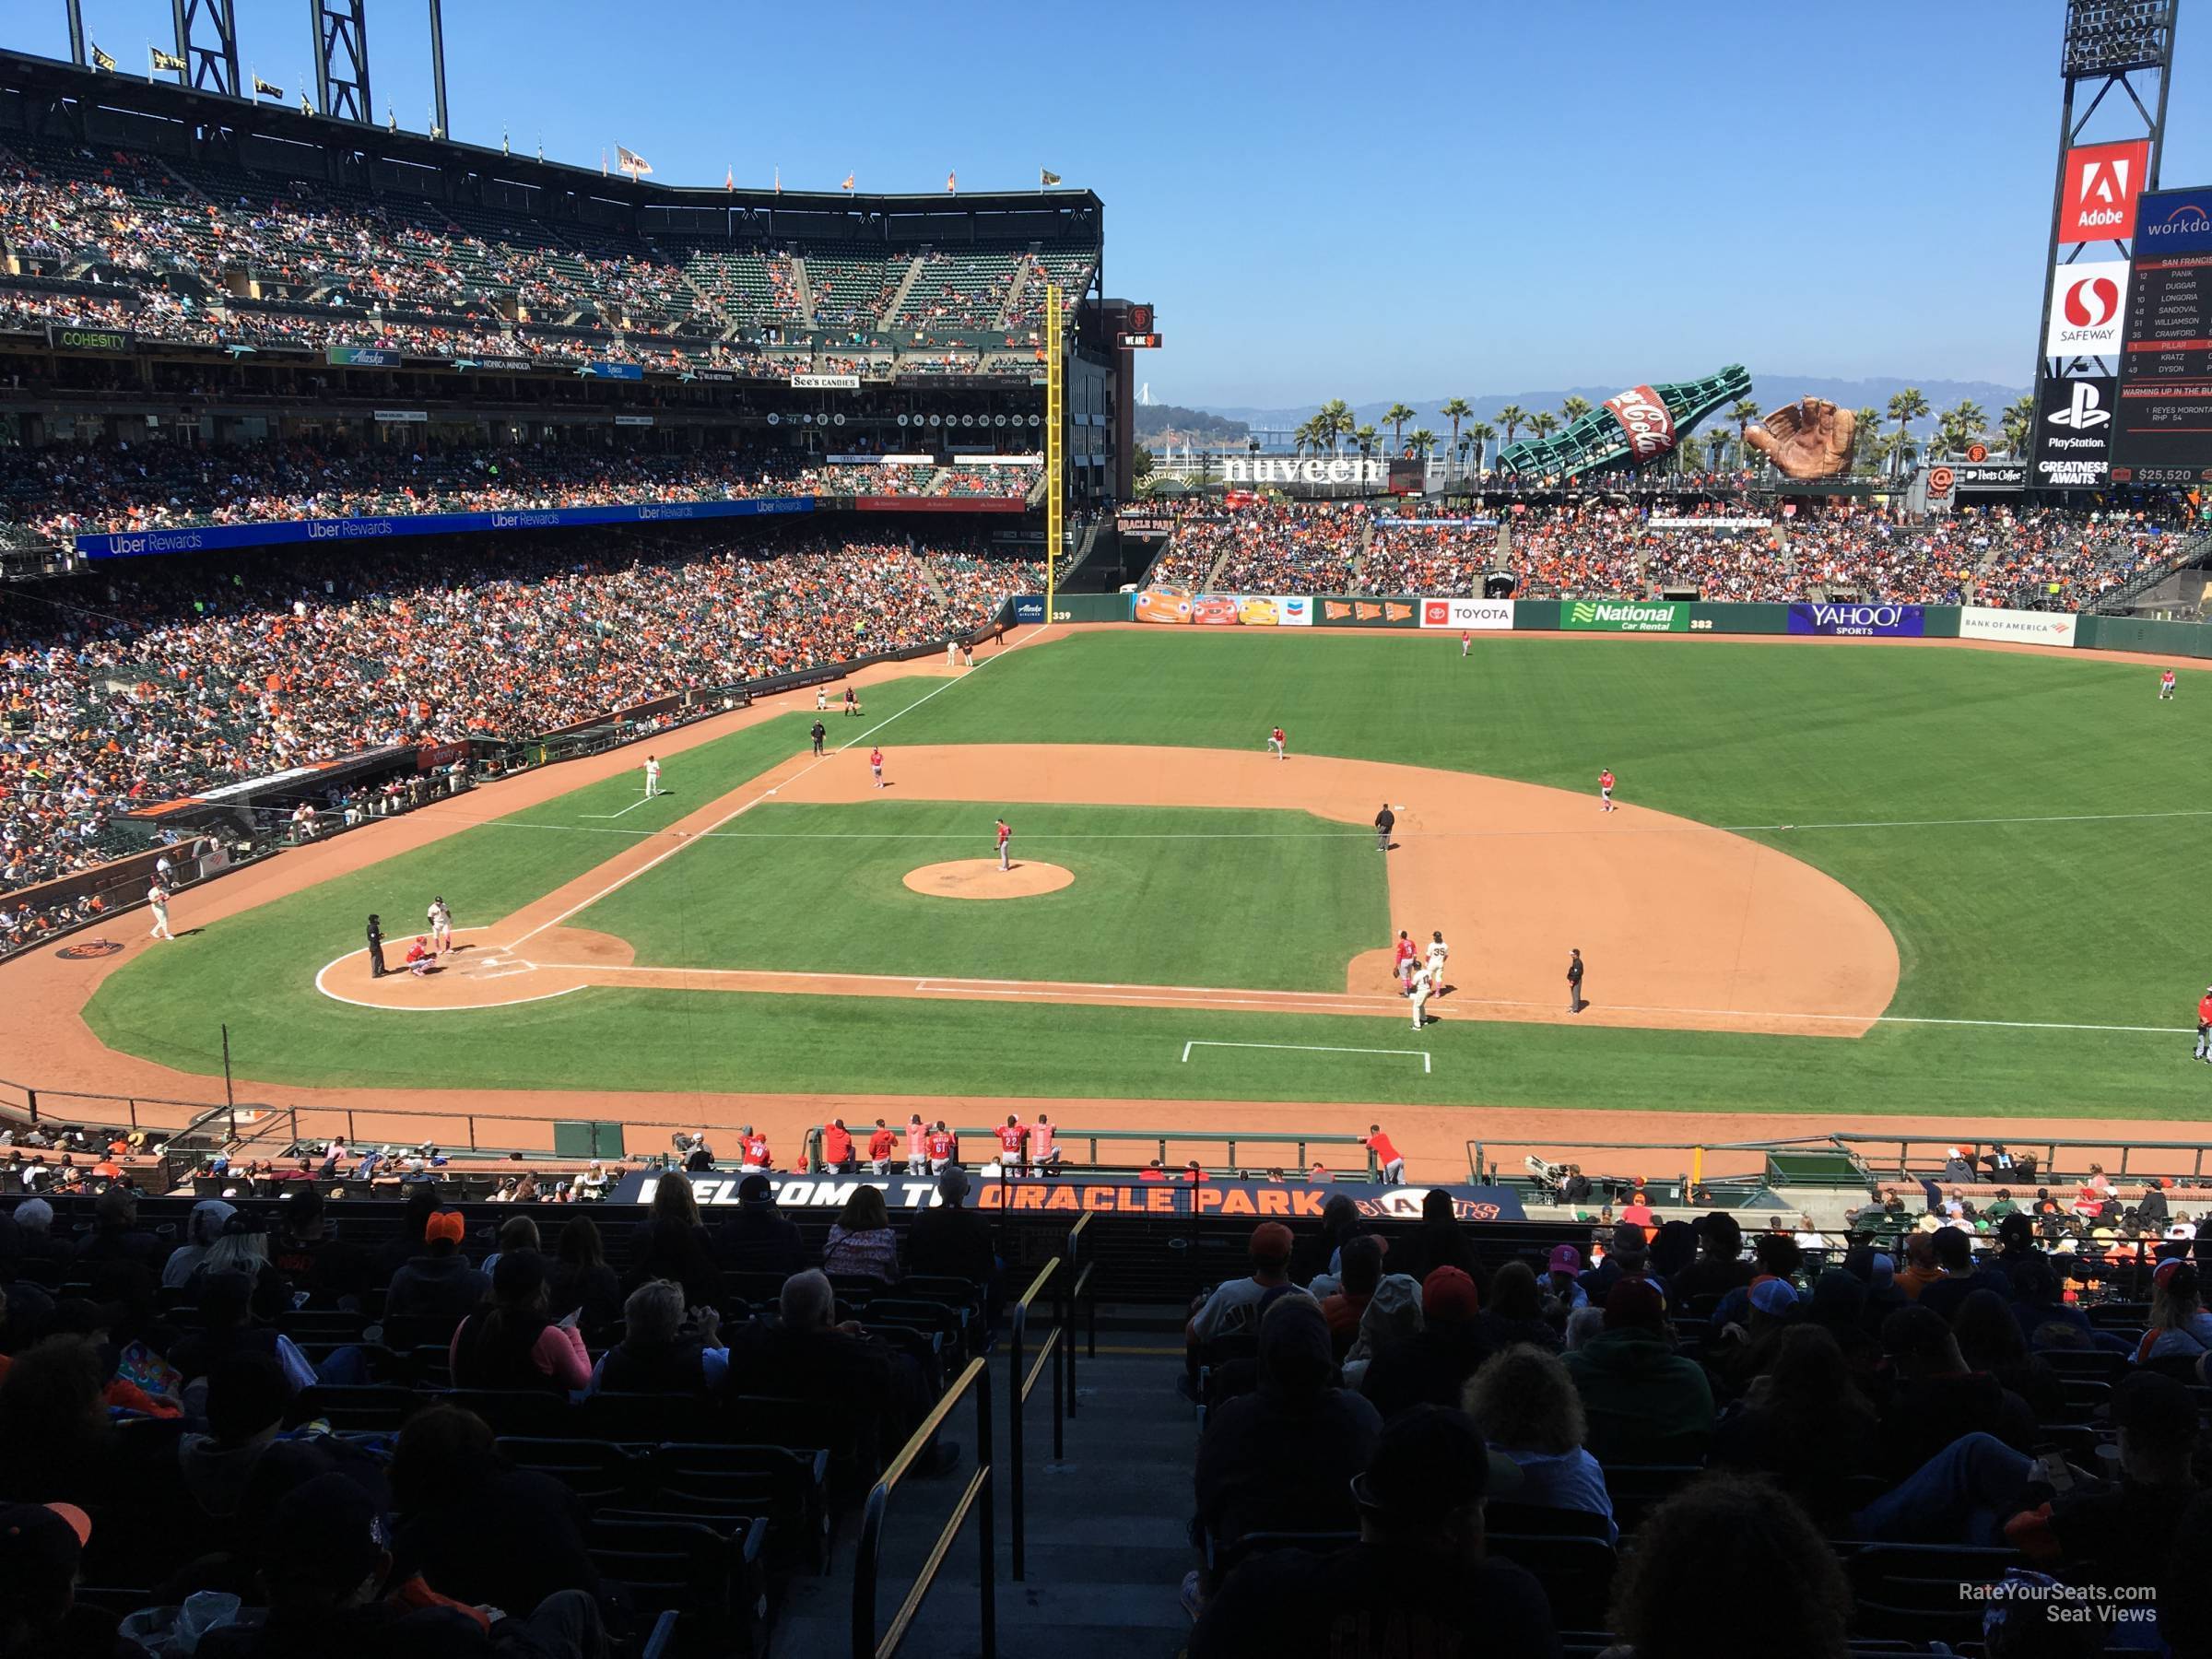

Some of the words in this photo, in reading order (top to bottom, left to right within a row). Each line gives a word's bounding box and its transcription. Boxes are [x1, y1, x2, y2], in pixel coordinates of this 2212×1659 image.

[2078, 208, 2124, 227] Adobe
[2148, 218, 2212, 236] workda
[2162, 259, 2179, 267] SAN
[2171, 270, 2194, 278] PANIK
[2165, 282, 2196, 290] DUGGAR
[2161, 294, 2198, 302] LONGORIA
[2159, 306, 2198, 314] SANDOVAL
[2154, 318, 2200, 326] WILLIAMSON
[2060, 329, 2115, 342] SAFEWAY
[2155, 329, 2196, 338] CRAWFORD
[63, 332, 125, 348] COHESITY
[1124, 335, 1135, 345] WE
[1135, 335, 1147, 345] ARE
[2161, 341, 2187, 349] PILLAR
[349, 348, 384, 365] Alaska
[483, 360, 506, 370] KONICA
[506, 362, 531, 371] MINOLTA
[2158, 365, 2184, 373] DYSON
[794, 376, 819, 386] See's
[2048, 437, 2105, 450] PlayStation
[1223, 460, 1379, 484] nuveen
[1998, 469, 2021, 481] Coffee
[2139, 468, 2192, 481] $25,520
[2049, 473, 2094, 485] AWAITS
[639, 506, 660, 519] Uber
[660, 505, 693, 519] Rewards
[757, 500, 775, 512] Uber
[775, 500, 803, 512] Rewards
[491, 512, 518, 527] Uber
[520, 512, 559, 525] Rewards
[1117, 519, 1151, 532] ORACLE
[1152, 519, 1175, 532] PARK
[307, 522, 339, 538] Uber
[342, 519, 393, 536] Rewards
[109, 536, 146, 554] Uber
[148, 532, 202, 551] Rewards
[1053, 611, 1071, 620] 339
[1453, 608, 1509, 619] TOYOTA
[1594, 605, 1676, 622] National
[1812, 605, 1903, 628] YAHOO!
[1621, 622, 1637, 630] Car
[1640, 622, 1670, 630] Rental
[1690, 619, 1712, 629] 382
[1965, 618, 1990, 628] BANK
[2006, 622, 2048, 631] AMERICA
[1836, 627, 1874, 635] SPORTS
[1434, 948, 1445, 957] 35
[750, 1147, 764, 1158] 90
[977, 1184, 1176, 1213] ORACLE
[1194, 1189, 1325, 1217] PARK
